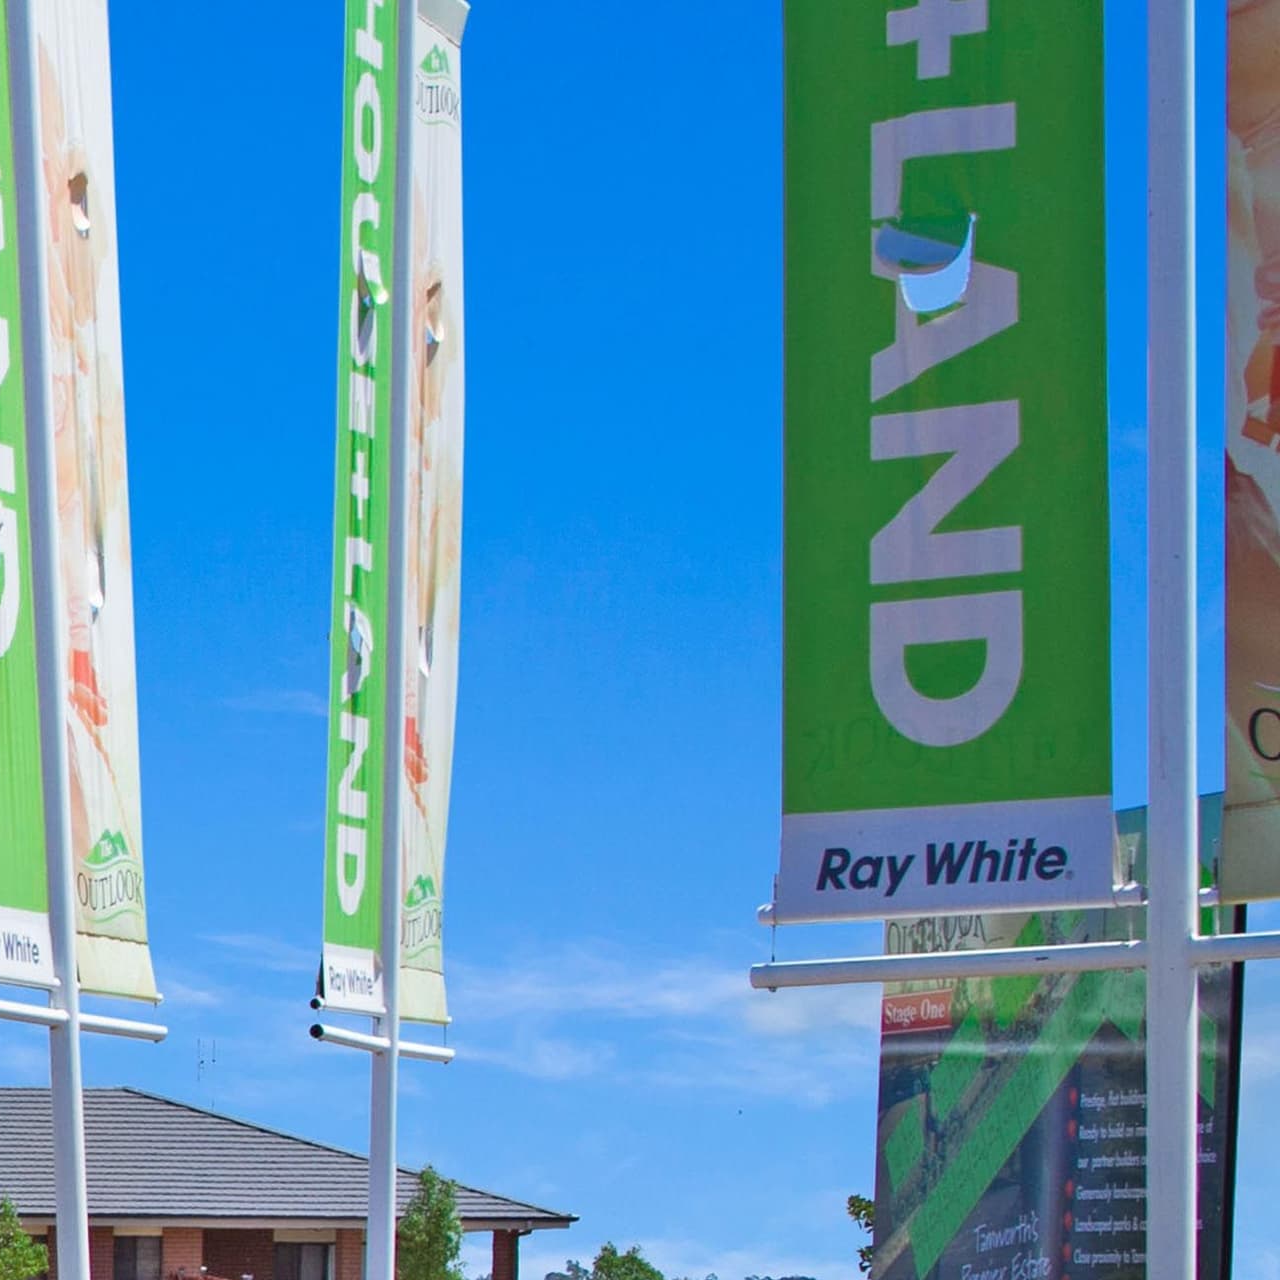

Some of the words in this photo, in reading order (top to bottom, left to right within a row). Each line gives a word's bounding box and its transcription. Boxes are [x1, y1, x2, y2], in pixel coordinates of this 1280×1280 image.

[816, 847, 916, 897] Ray
[926, 838, 1068, 887] White
[77, 869, 143, 911] OUTLOOK
[2, 931, 40, 964] White
[329, 965, 346, 997] Ray
[346, 967, 373, 996] White
[884, 1002, 917, 1027] Stage
[920, 998, 946, 1020] One
[1108, 1122, 1125, 1138] build
